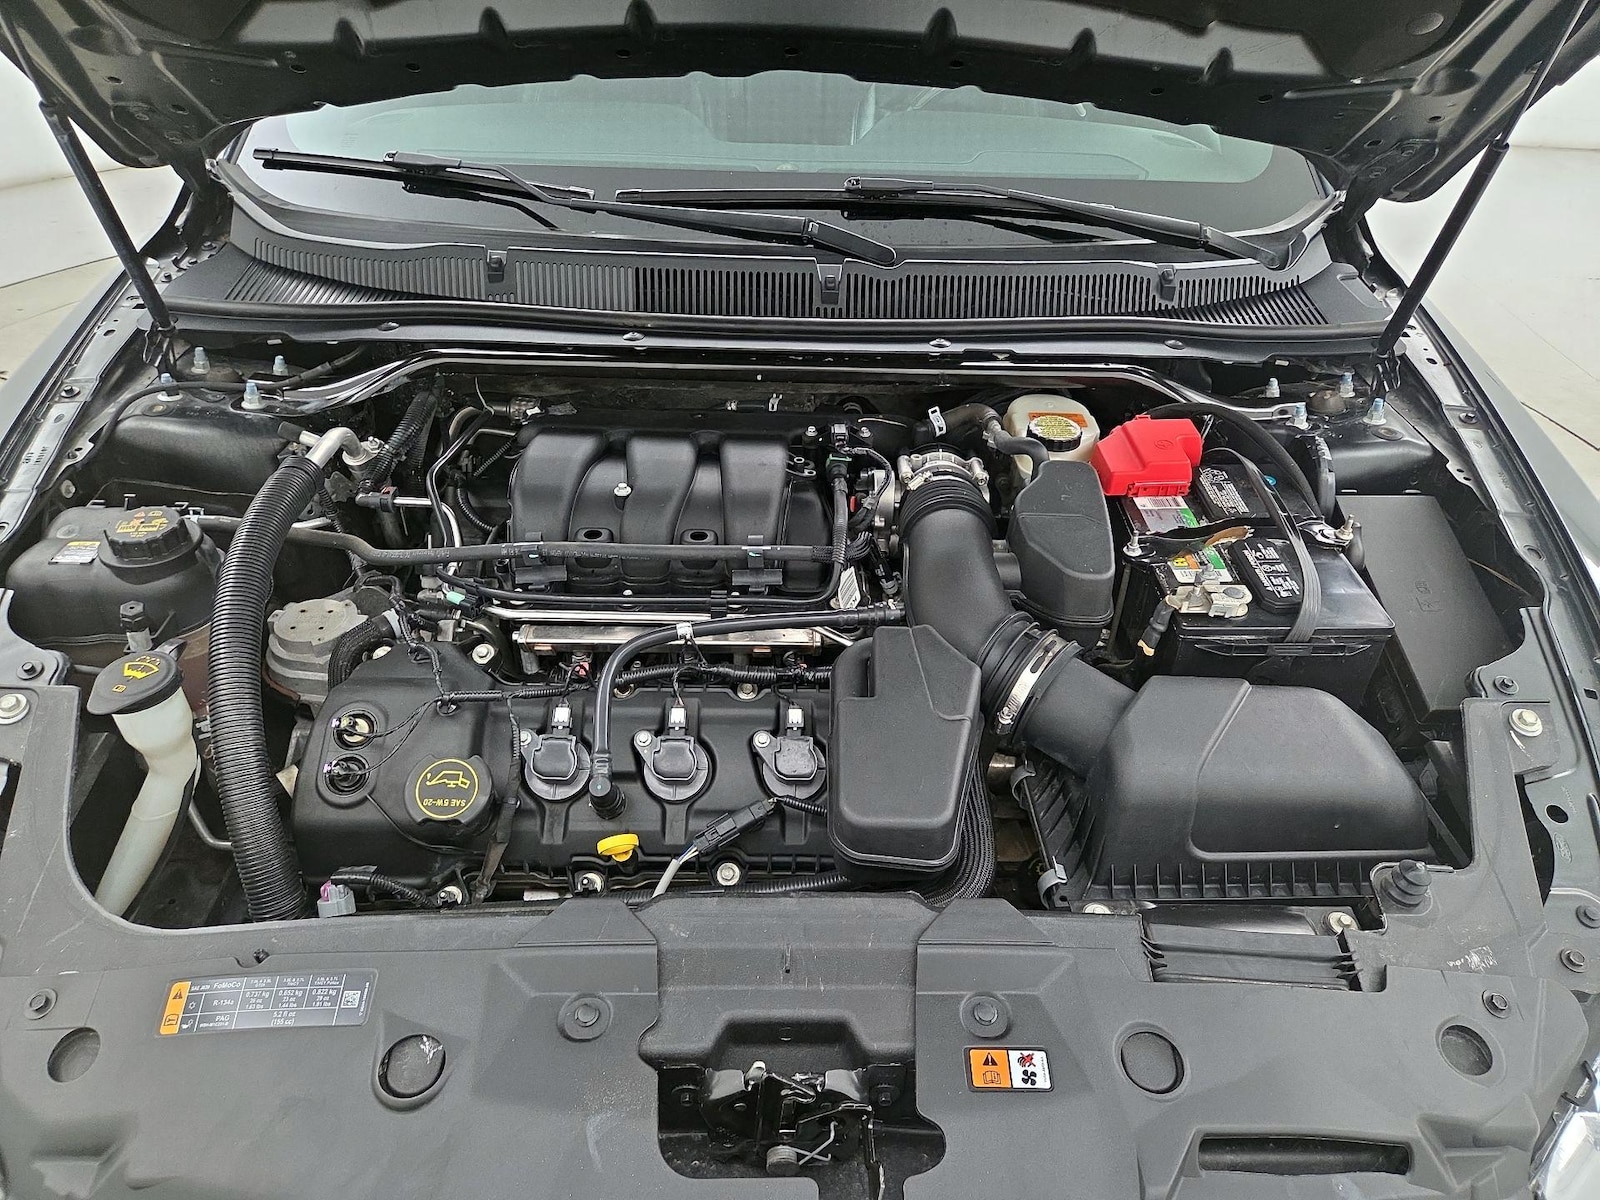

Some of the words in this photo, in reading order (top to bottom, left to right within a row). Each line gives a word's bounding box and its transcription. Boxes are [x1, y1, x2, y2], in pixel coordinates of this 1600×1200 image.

[423, 798, 449, 807] 5W-20
[450, 799, 466, 807] SAE
[213, 981, 241, 989] FoMoCo
[261, 991, 270, 999] kg
[294, 989, 303, 997] kg
[328, 988, 337, 996] kg
[273, 1010, 283, 1018] 5.2
[271, 1018, 284, 1026] (155
